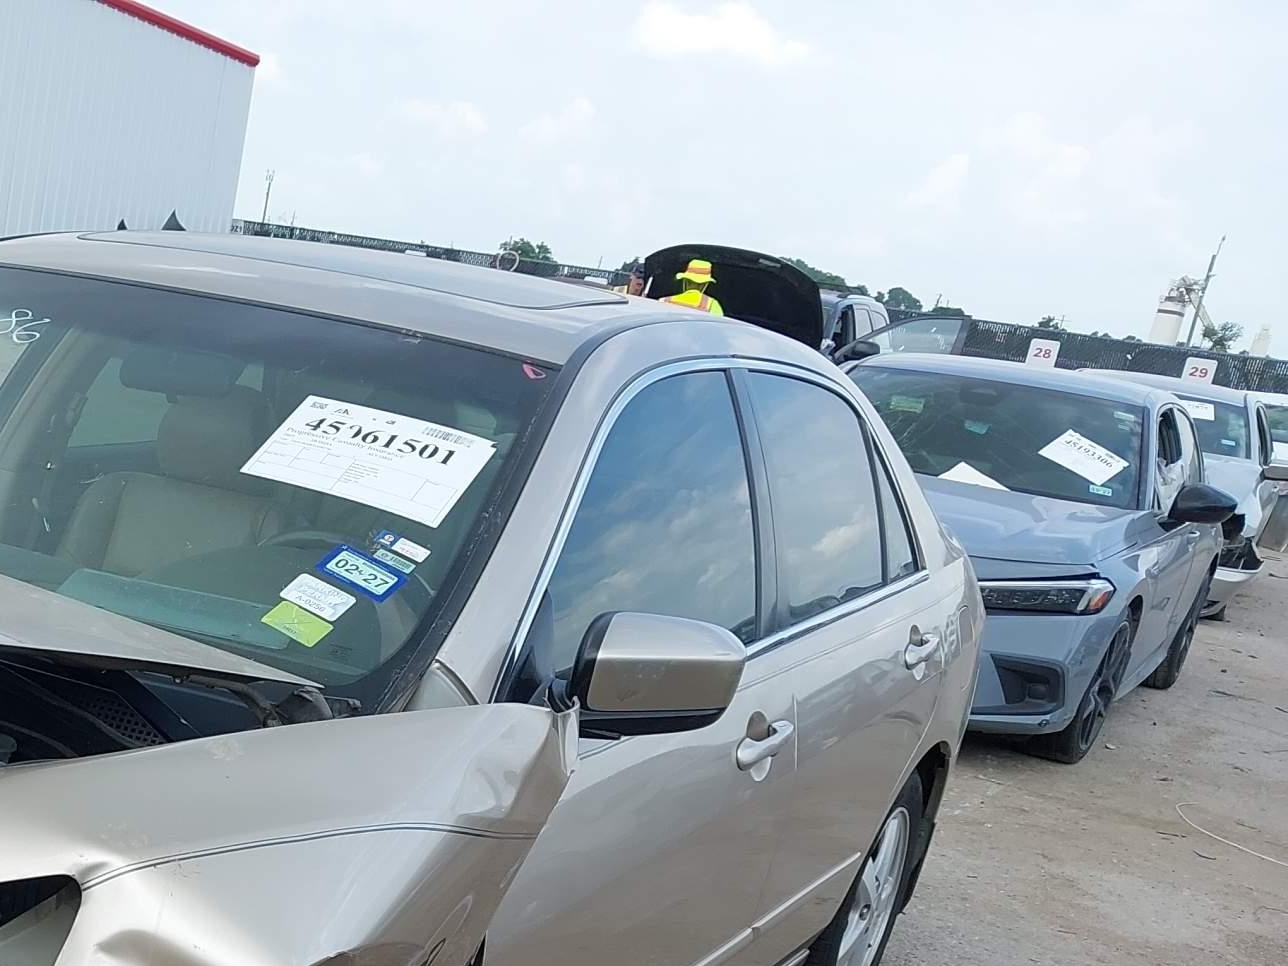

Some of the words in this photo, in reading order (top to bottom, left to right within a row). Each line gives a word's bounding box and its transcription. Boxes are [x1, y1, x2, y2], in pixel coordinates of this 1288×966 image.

[1033, 347, 1053, 359] 28
[1188, 366, 1209, 379] 29
[334, 558, 360, 575] 02
[362, 573, 390, 588] 27
